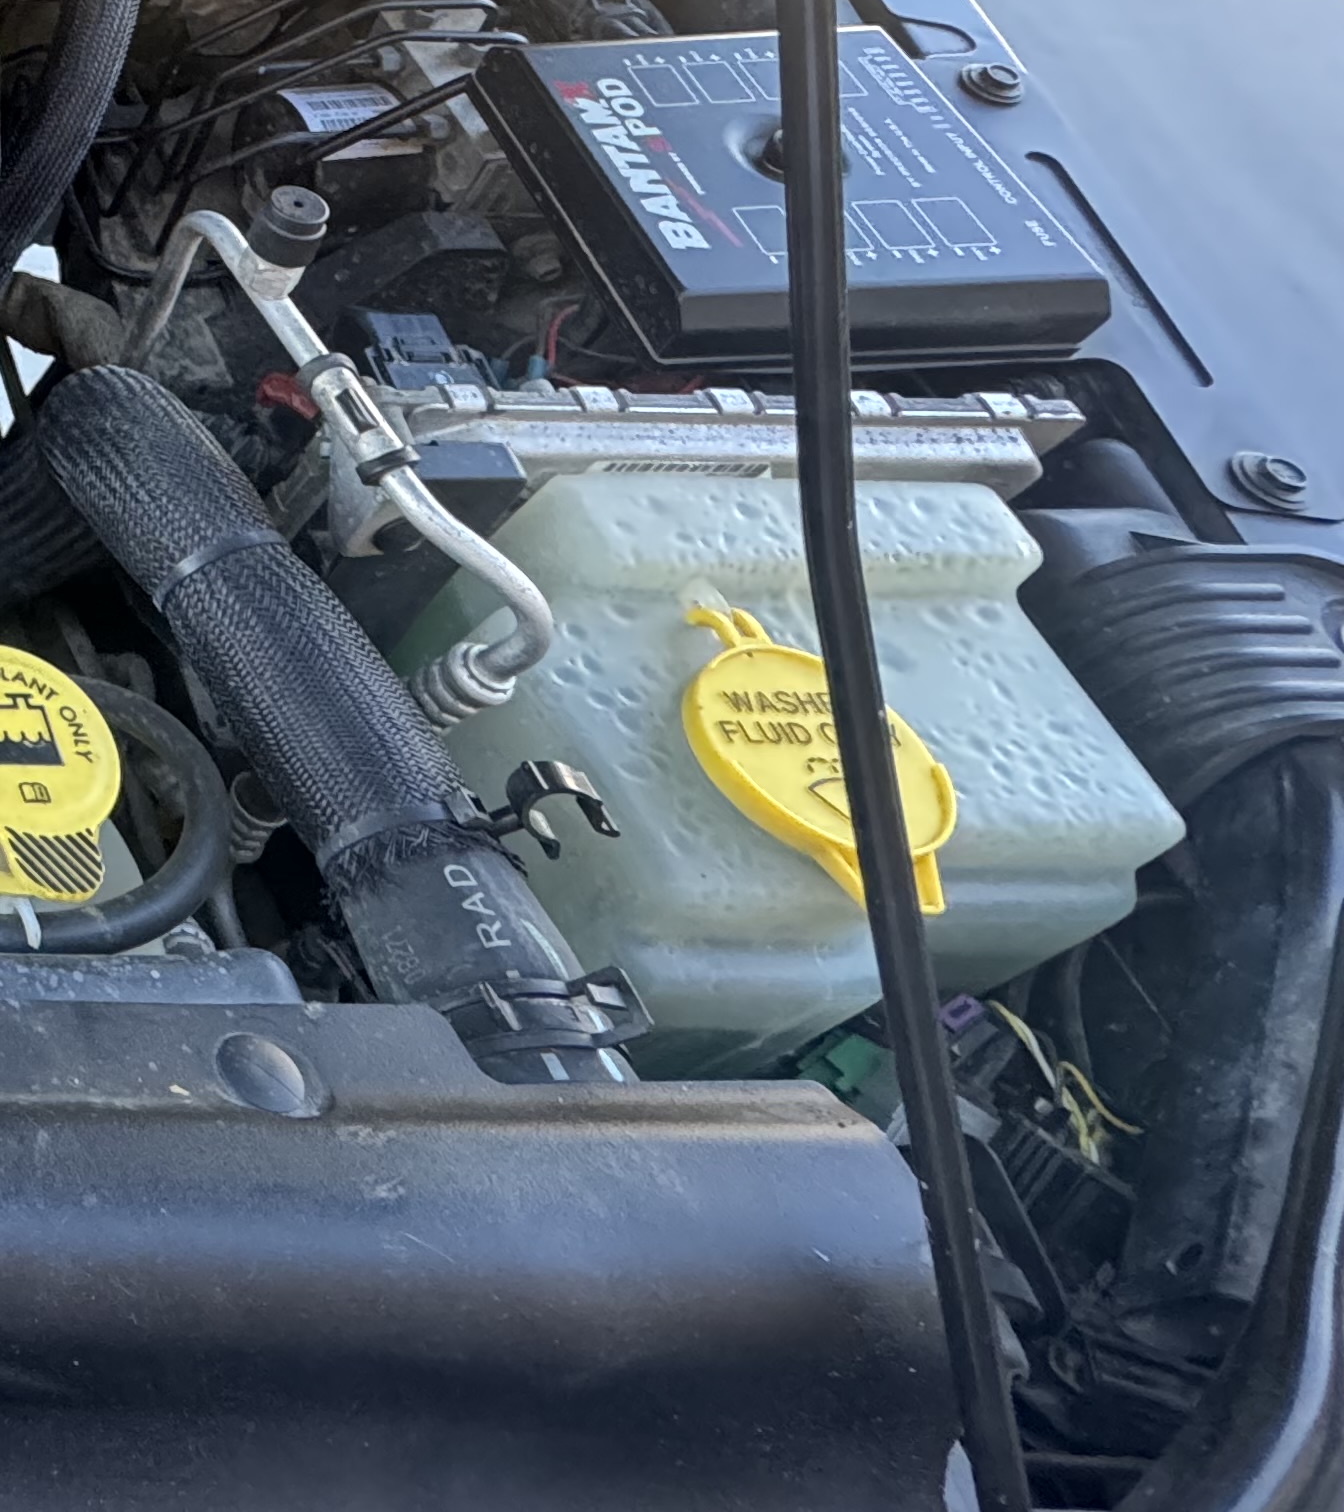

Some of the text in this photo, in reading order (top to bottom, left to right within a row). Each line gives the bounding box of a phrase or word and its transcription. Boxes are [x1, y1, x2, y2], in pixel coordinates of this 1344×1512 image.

[945, 131, 1057, 247] FUSE CONTROL INPUT
[721, 690, 831, 715] WASH
[59, 706, 94, 763] ONLY
[715, 720, 812, 745] FLUID
[444, 864, 512, 948] RAD
